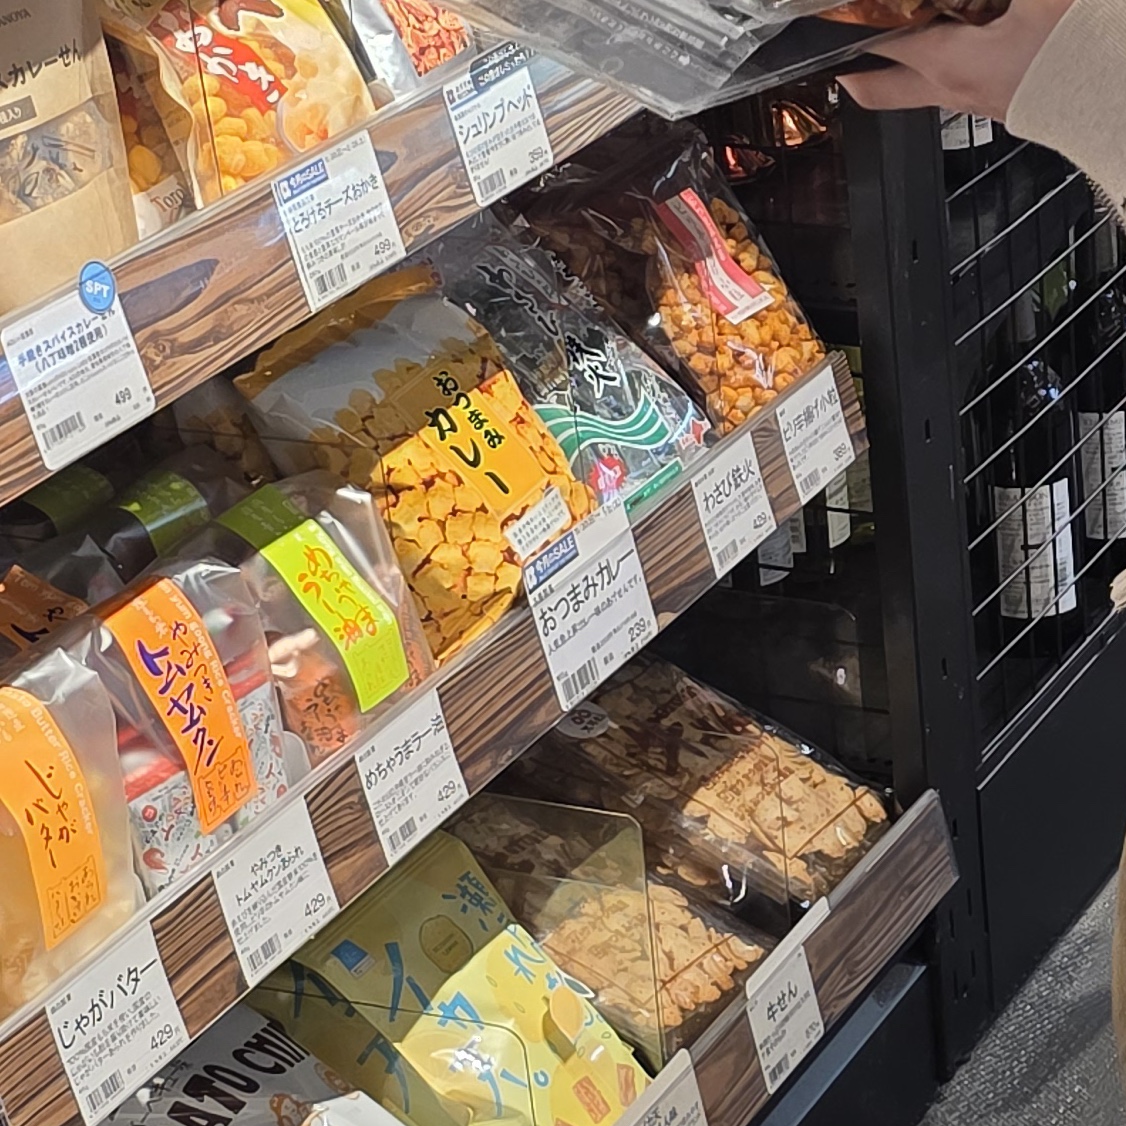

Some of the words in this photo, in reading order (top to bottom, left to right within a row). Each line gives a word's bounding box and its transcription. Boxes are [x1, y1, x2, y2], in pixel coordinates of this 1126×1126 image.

[457, 84, 534, 145] シュリンプヘッド
[291, 174, 380, 235] とろけるチーズおかき
[436, 371, 506, 449] おつまみ
[424, 407, 510, 494] カレー
[701, 457, 756, 514] わさび鉄火
[538, 547, 636, 637] おつまみカレー
[136, 638, 224, 777] トムヤムクン
[73, 781, 95, 836] Cracker
[233, 845, 305, 907] トムヤムクンあられ
[250, 844, 283, 876] やみつき
[56, 956, 158, 1050] じゃがバター
